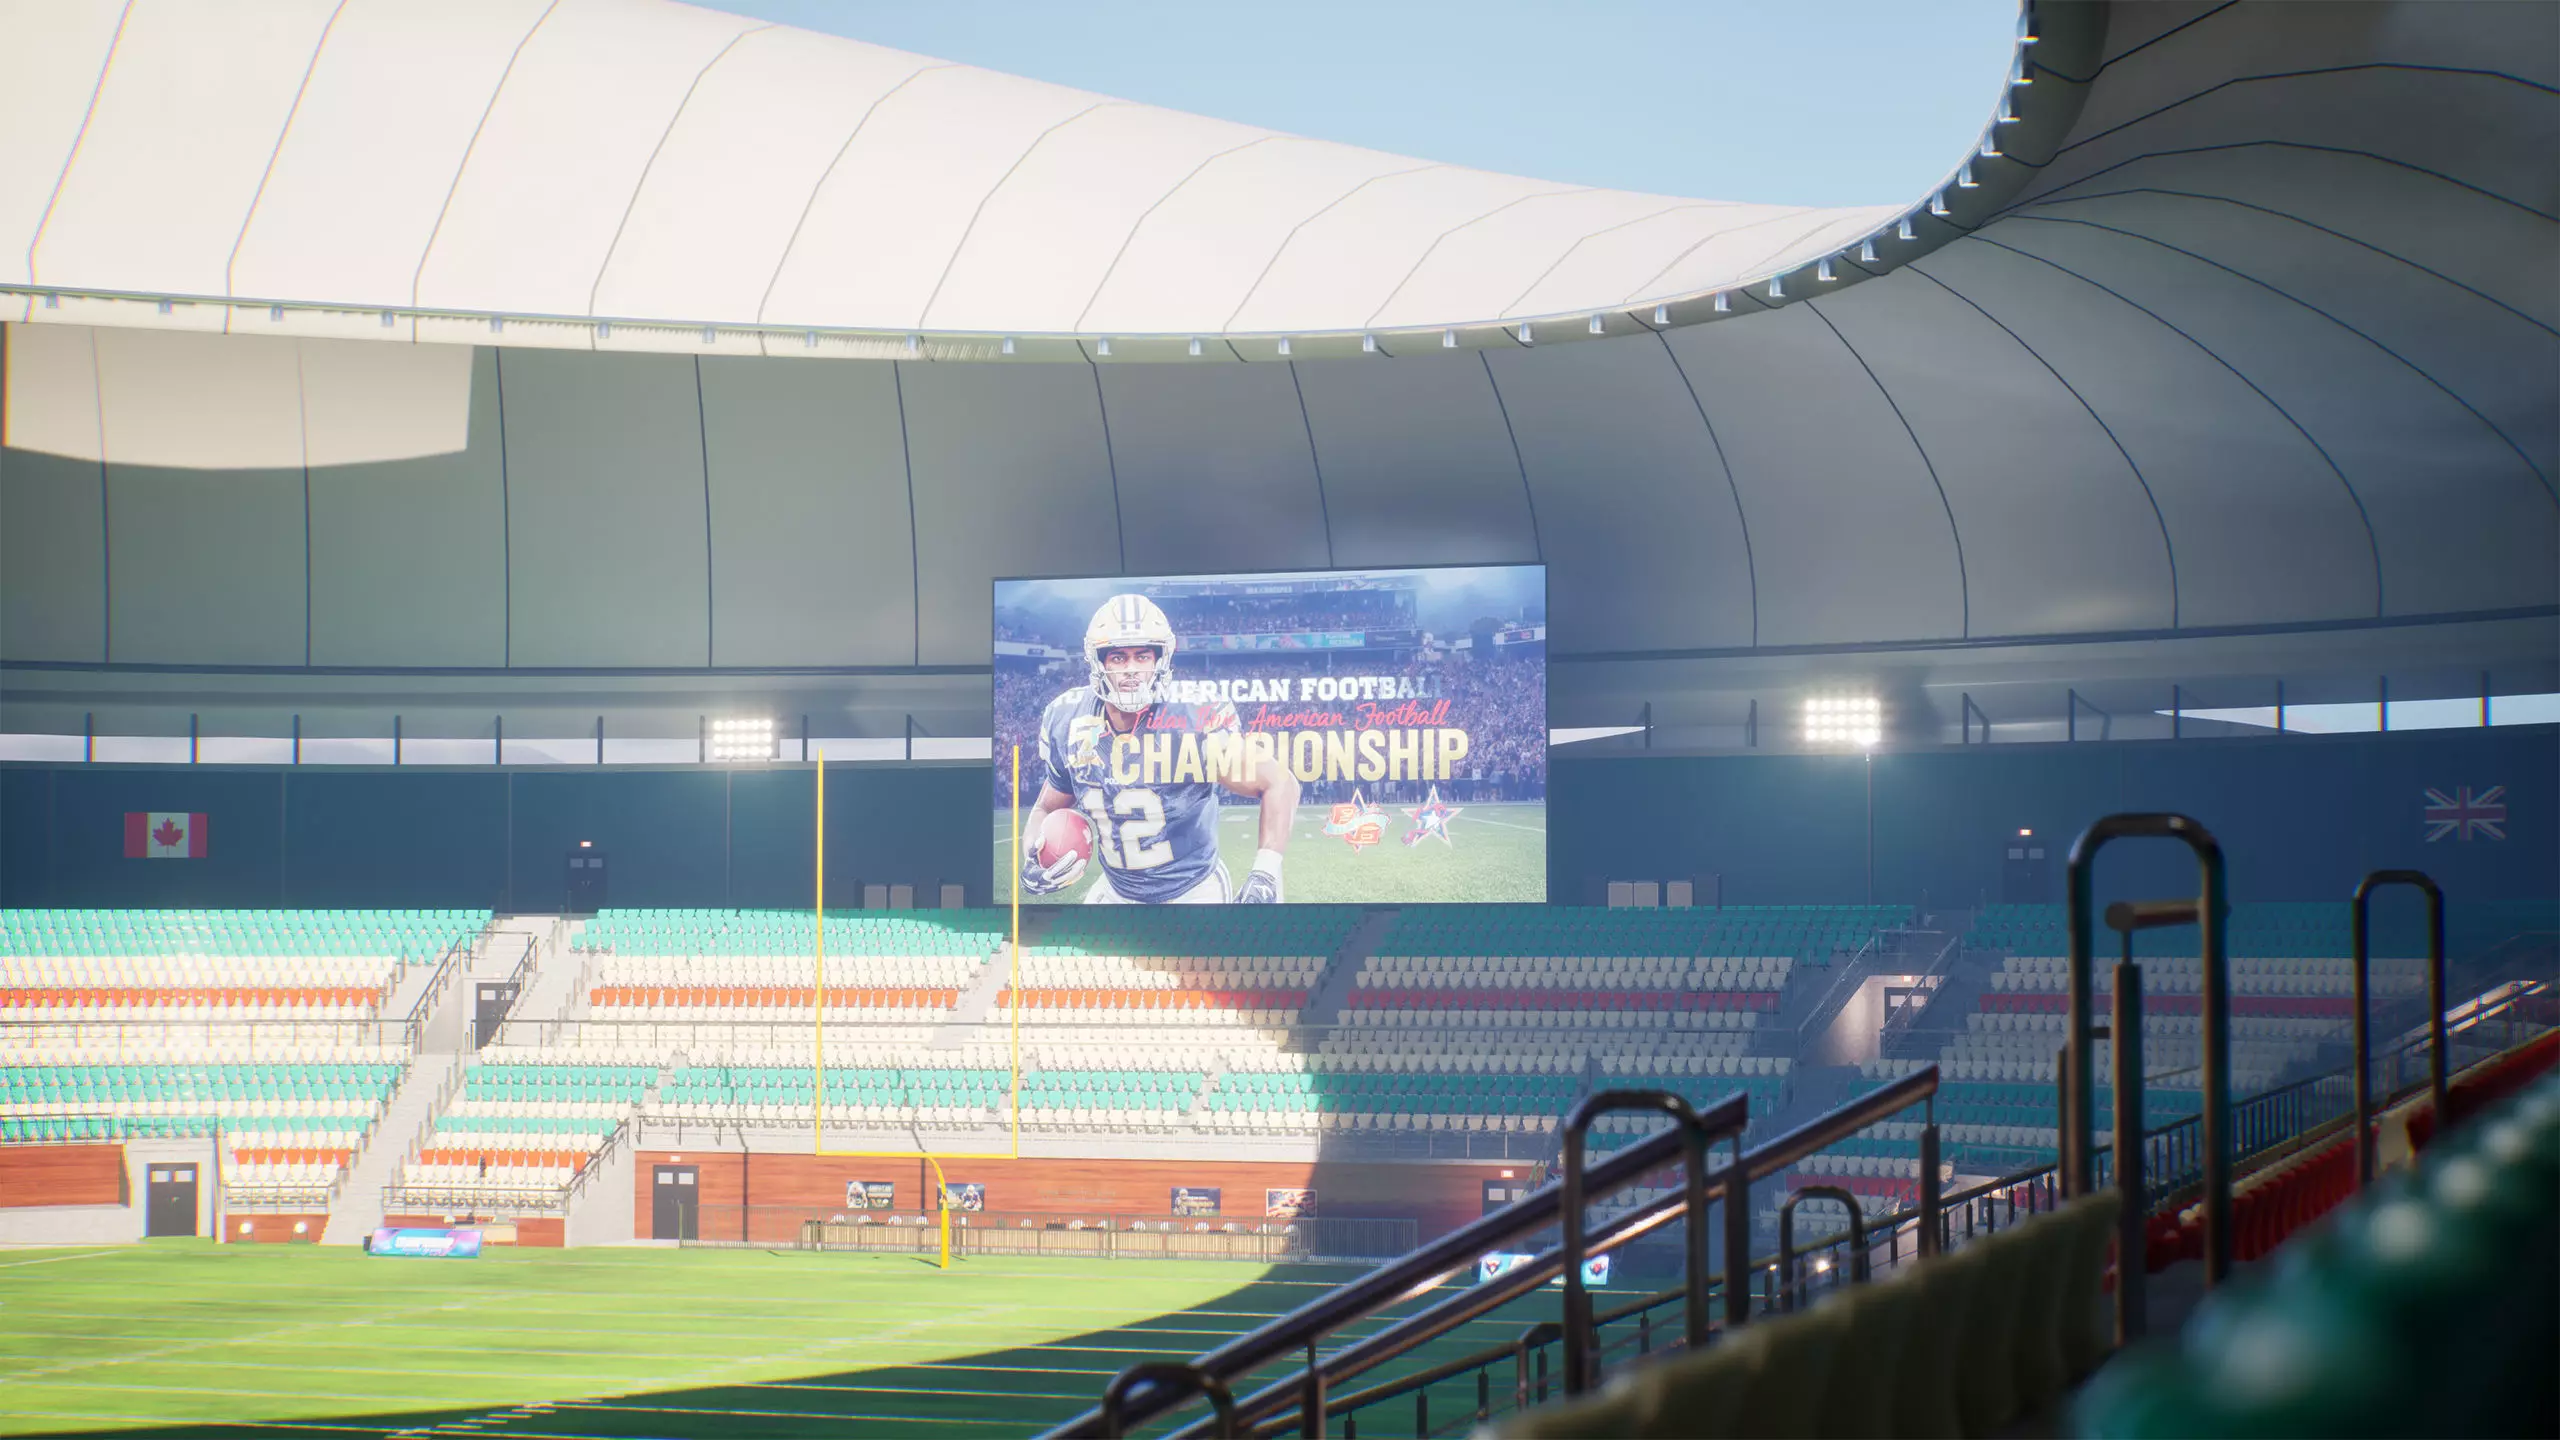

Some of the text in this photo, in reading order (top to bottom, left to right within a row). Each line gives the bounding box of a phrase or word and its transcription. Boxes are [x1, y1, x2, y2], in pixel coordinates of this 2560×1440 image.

[1247, 703, 1346, 737] American
[1355, 699, 1451, 732] Football
[1110, 727, 1469, 785] CHAMPIONSHIP
[1081, 788, 1175, 870] 12
